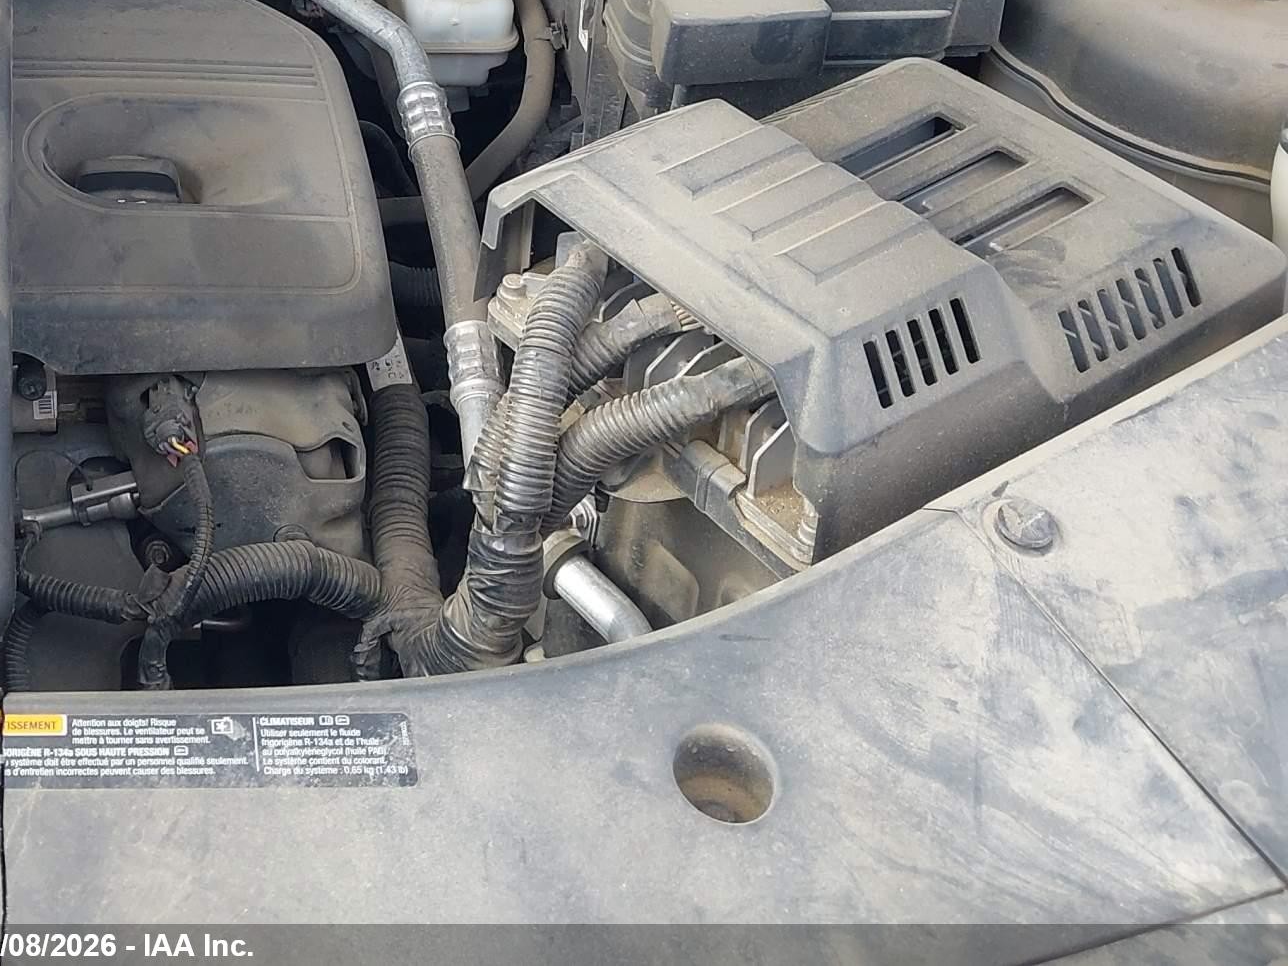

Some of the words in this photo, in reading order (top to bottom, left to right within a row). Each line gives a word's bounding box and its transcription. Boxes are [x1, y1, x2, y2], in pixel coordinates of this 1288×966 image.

[260, 717, 314, 726] CLIMATISEUR
[44, 747, 73, 756] R-134a
[75, 747, 97, 756] SOUS
[99, 747, 126, 756] HAUTE
[128, 747, 170, 756] PRESSION
